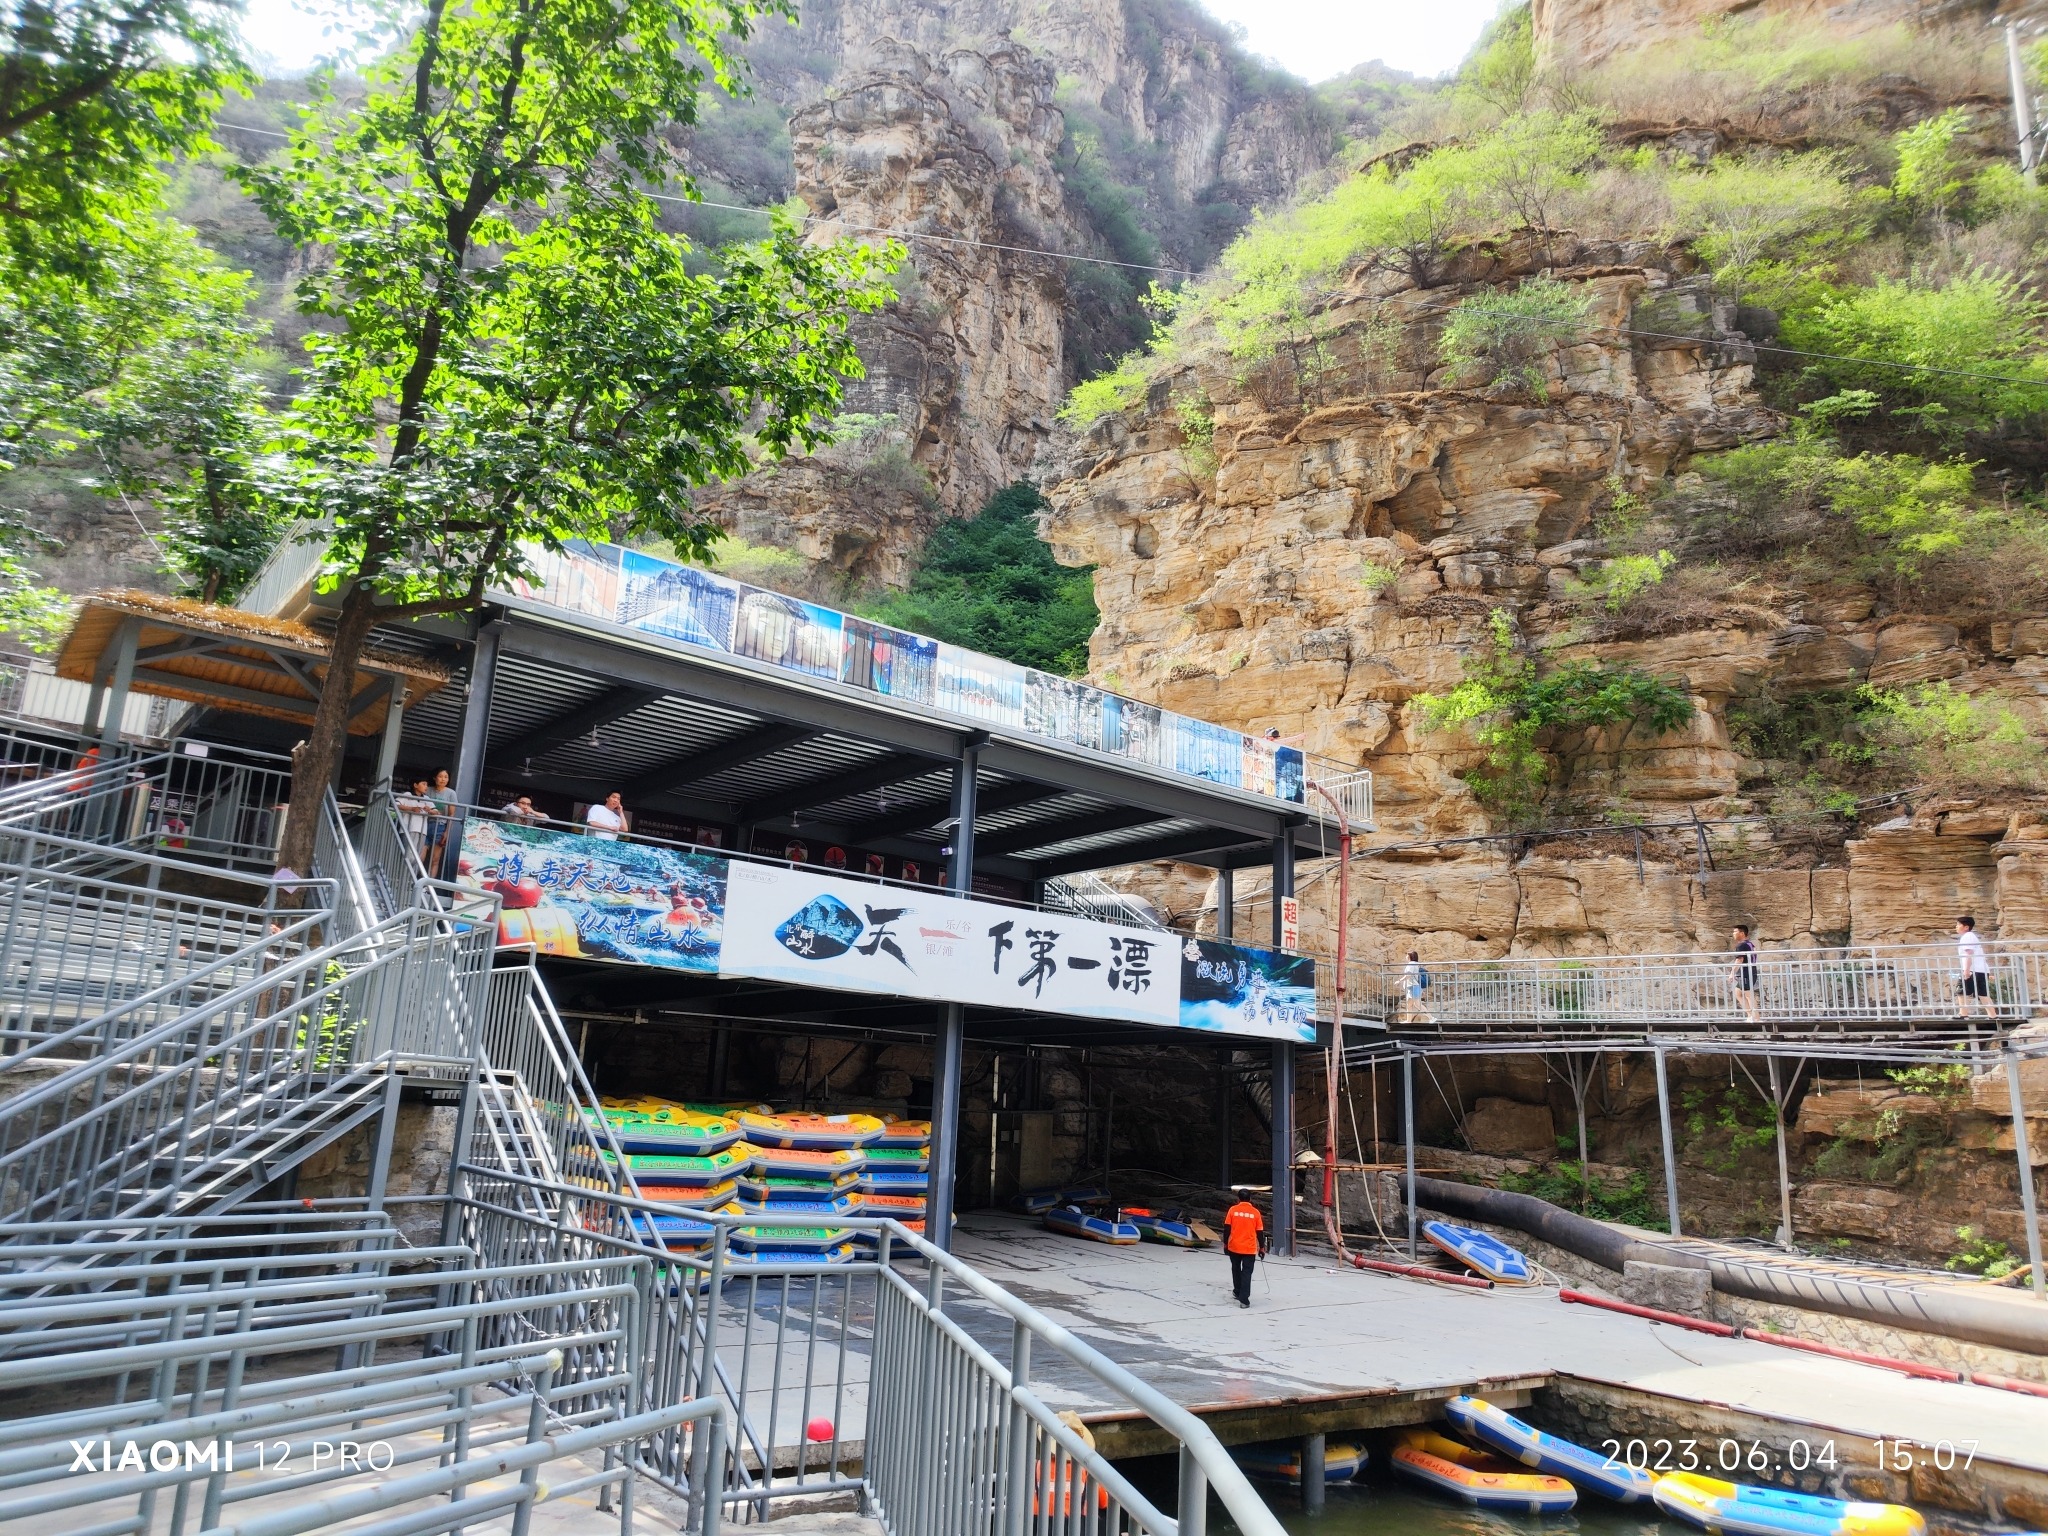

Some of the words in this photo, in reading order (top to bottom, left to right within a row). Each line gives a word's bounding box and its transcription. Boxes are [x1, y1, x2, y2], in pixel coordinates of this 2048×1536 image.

[497, 851, 632, 894] 搏击天地
[578, 910, 707, 949] 纵情山水
[1283, 901, 1298, 948] 超市
[1196, 960, 1267, 990] 激流勇进
[1243, 996, 1308, 1028] 荡气回肠
